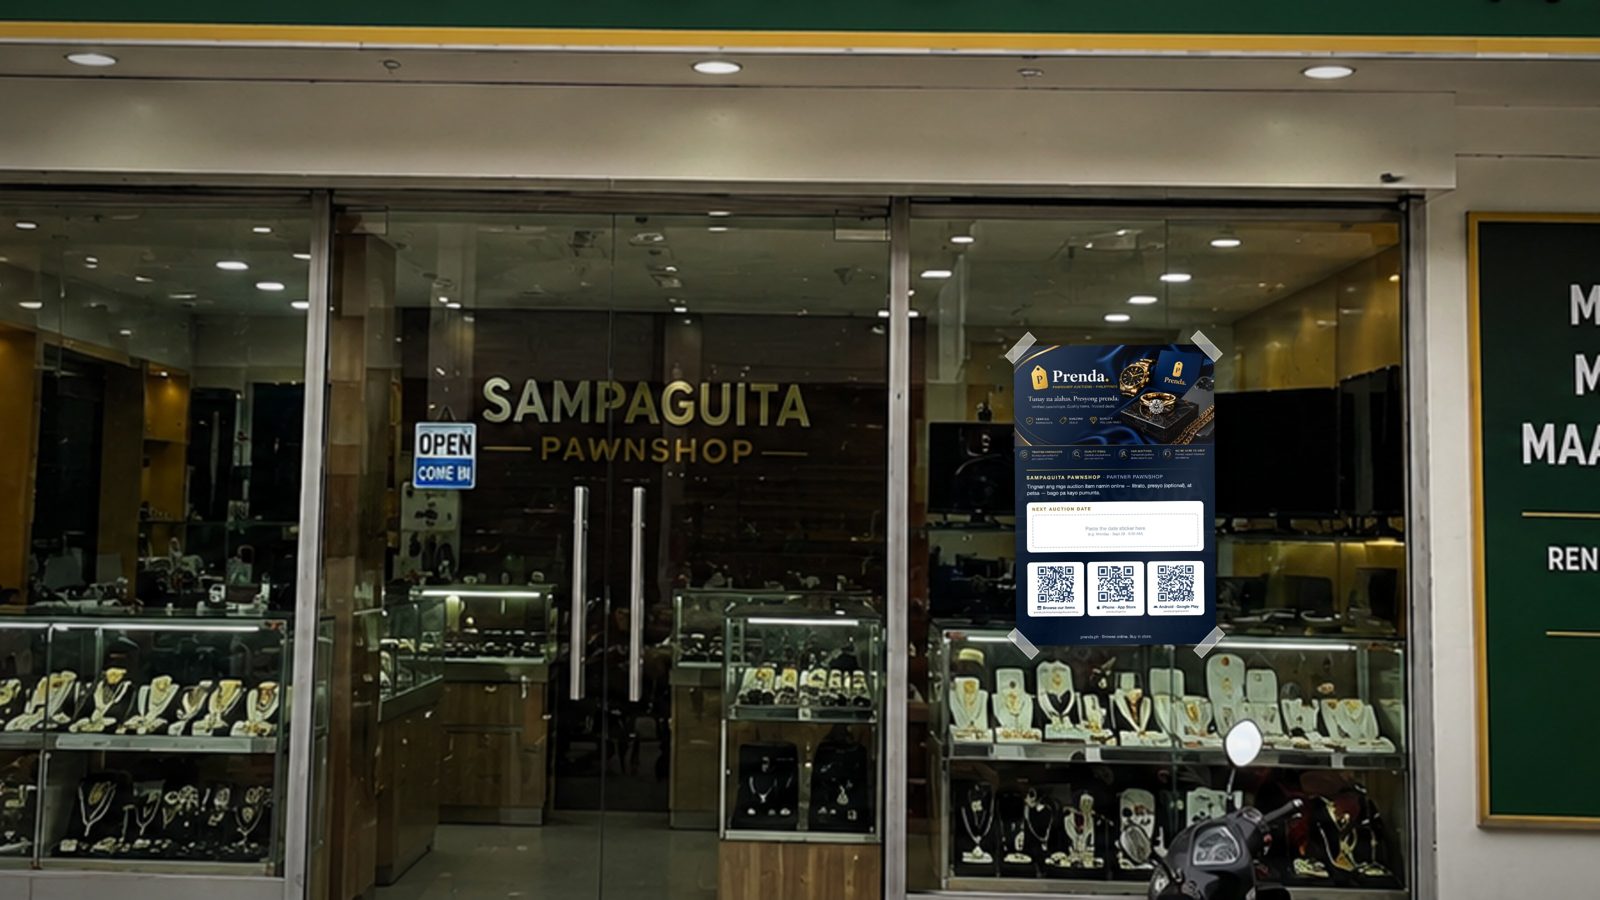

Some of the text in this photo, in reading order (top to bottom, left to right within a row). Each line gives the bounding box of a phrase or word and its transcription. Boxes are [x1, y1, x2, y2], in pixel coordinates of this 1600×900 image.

[1053, 369, 1110, 383] Prenda.
[482, 376, 811, 428] SAMPAGUITA
[419, 433, 472, 456] OPEN
[541, 435, 754, 464] PAWNSHOP
[1548, 546, 1598, 571] REN
